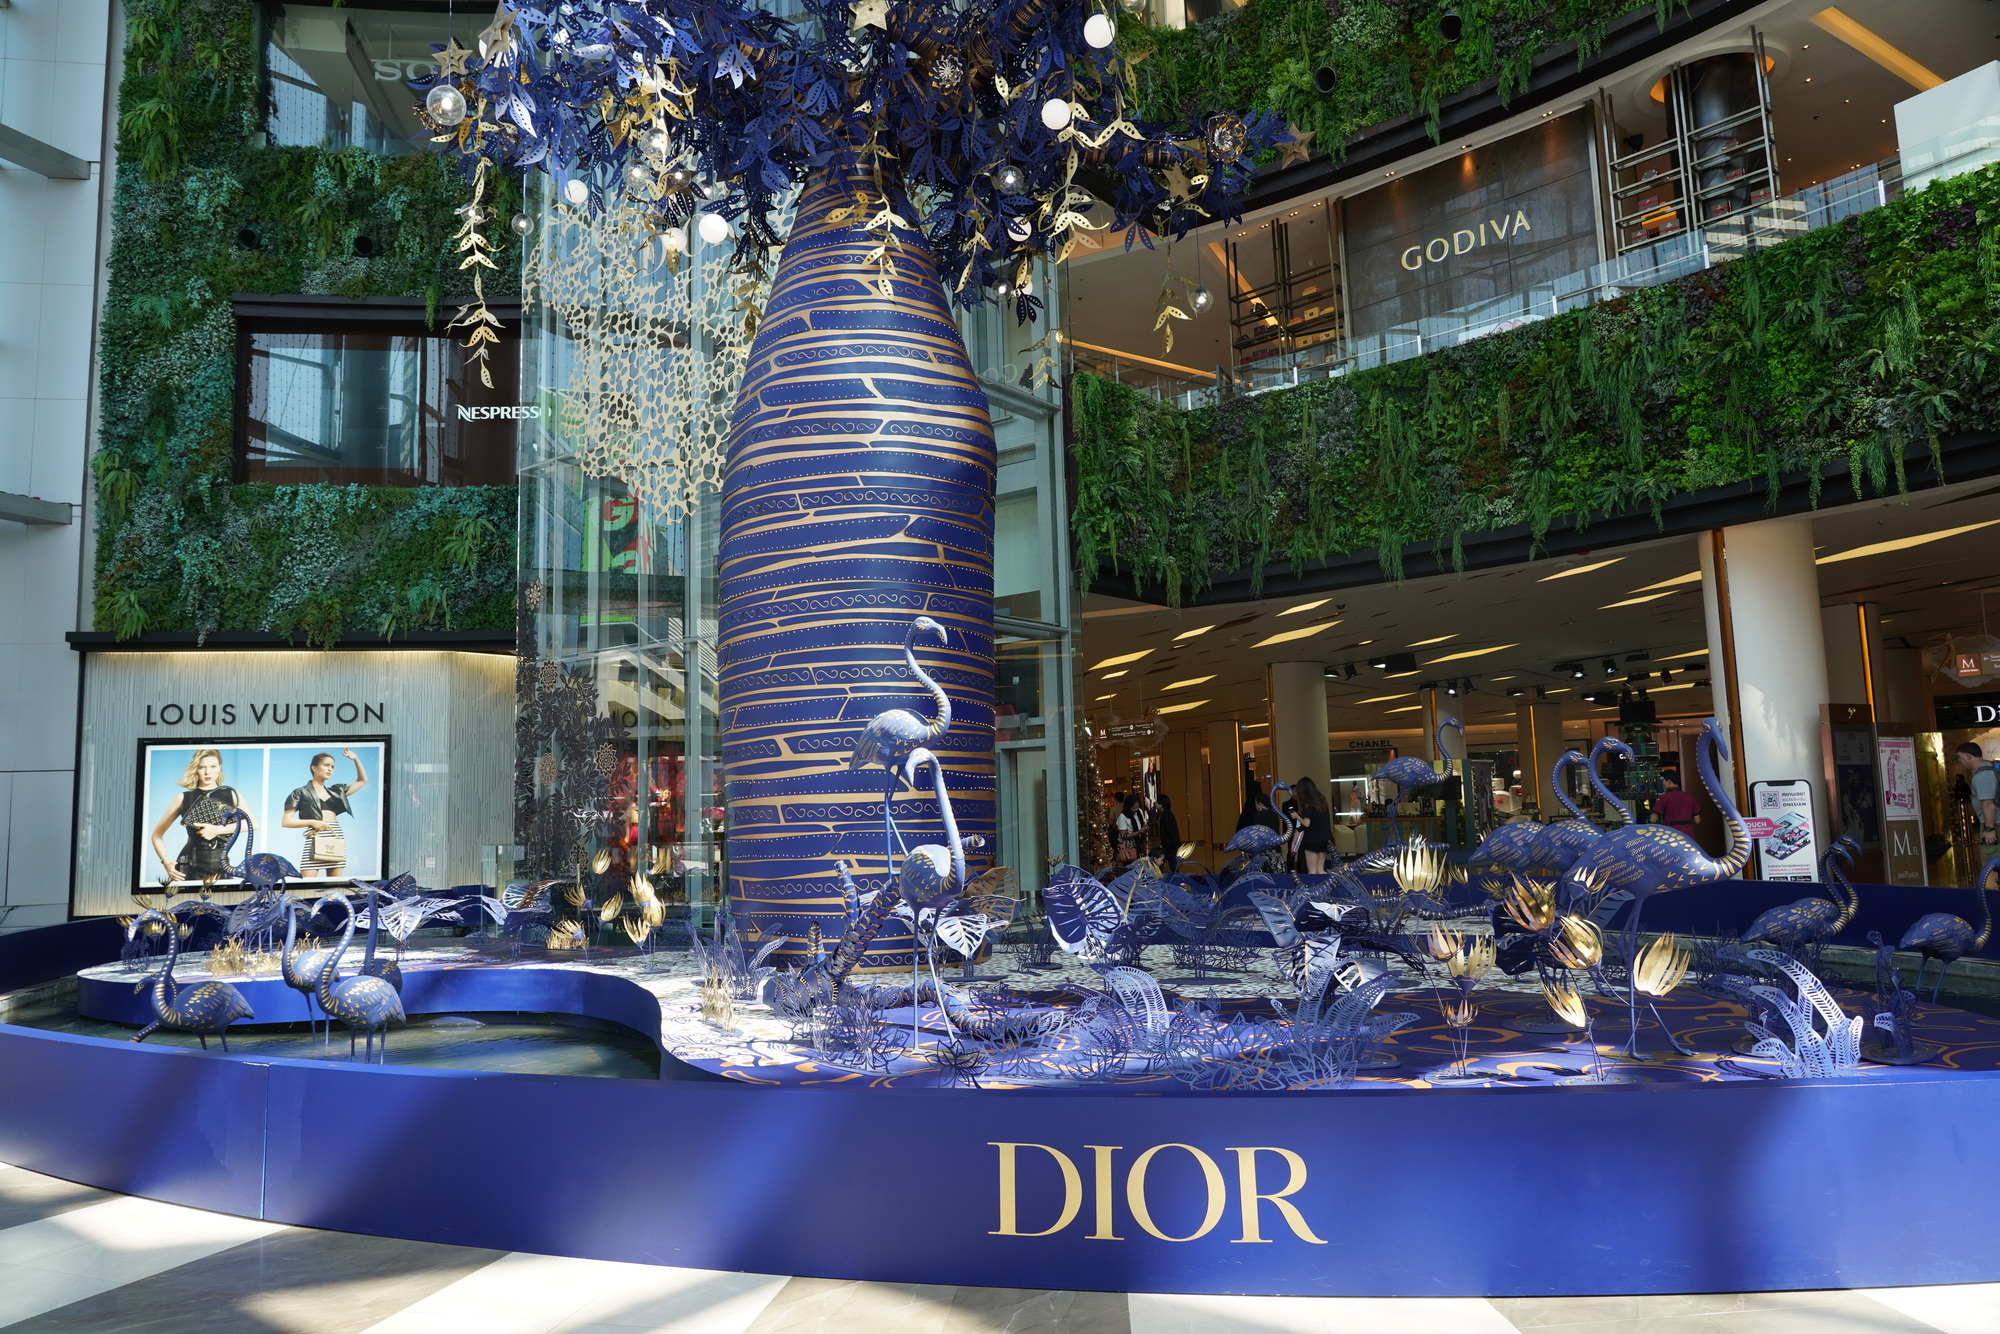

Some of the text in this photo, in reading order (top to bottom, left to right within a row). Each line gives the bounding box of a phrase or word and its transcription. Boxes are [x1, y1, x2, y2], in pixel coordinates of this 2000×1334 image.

[1401, 210, 1531, 271] GODIVA
[454, 403, 552, 423] NESPRESSO
[1961, 657, 1976, 669] M
[146, 702, 384, 726] LOUIS VUITTON
[1349, 740, 1393, 748] CHANEL
[987, 1142, 1328, 1244] DIOR
